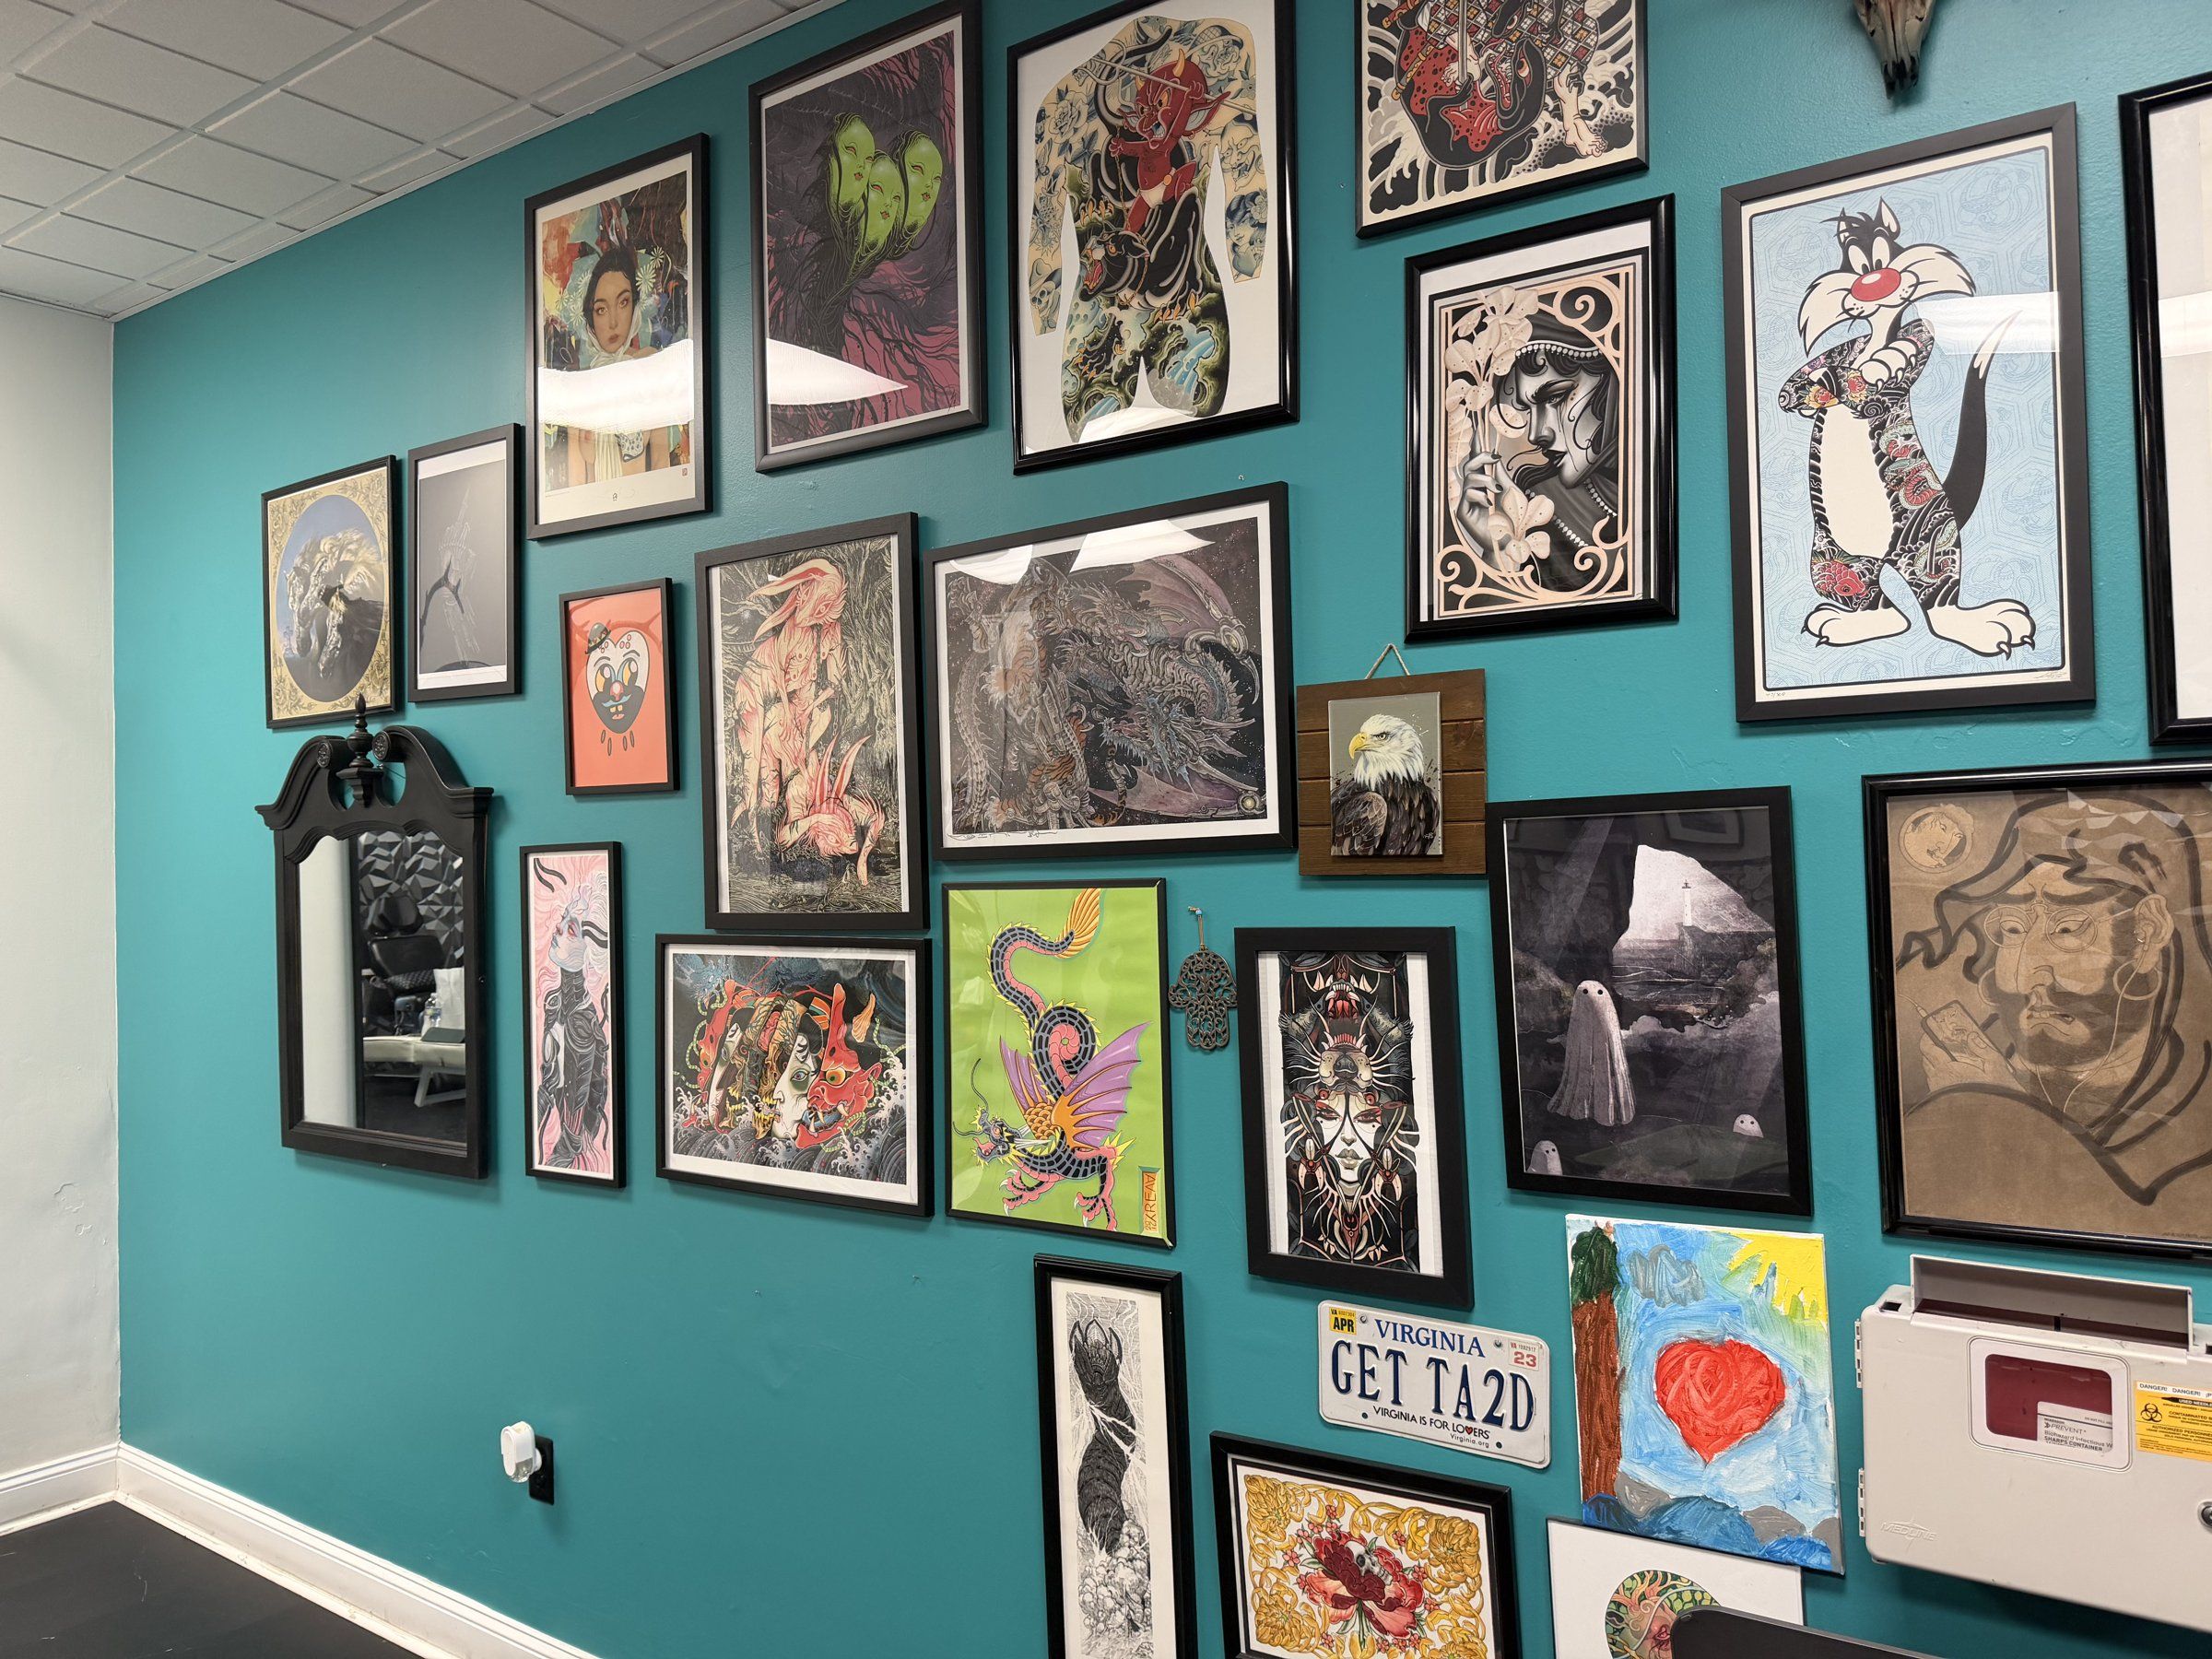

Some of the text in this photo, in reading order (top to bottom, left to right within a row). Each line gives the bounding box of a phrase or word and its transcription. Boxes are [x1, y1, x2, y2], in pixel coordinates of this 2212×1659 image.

[1333, 1316, 1355, 1334] APR
[1374, 1319, 1486, 1358] VIRGINIA
[1513, 1351, 1537, 1368] 23
[1331, 1339, 1535, 1431] GET TA2D
[2139, 1382, 2168, 1392] DANGER!
[2171, 1387, 2201, 1396] DANGER!
[1373, 1406, 1418, 1424] VIRGINIA
[1419, 1416, 1428, 1426] IS
[1430, 1418, 1451, 1431] FOR
[2044, 1430, 2075, 1441] Biohazard
[2050, 1423, 2083, 1434] PREVENT
[1450, 1433, 1489, 1448] Virginia.org
[2043, 1436, 2068, 1445] SHARPS
[2068, 1441, 2103, 1452] CONTAINER
